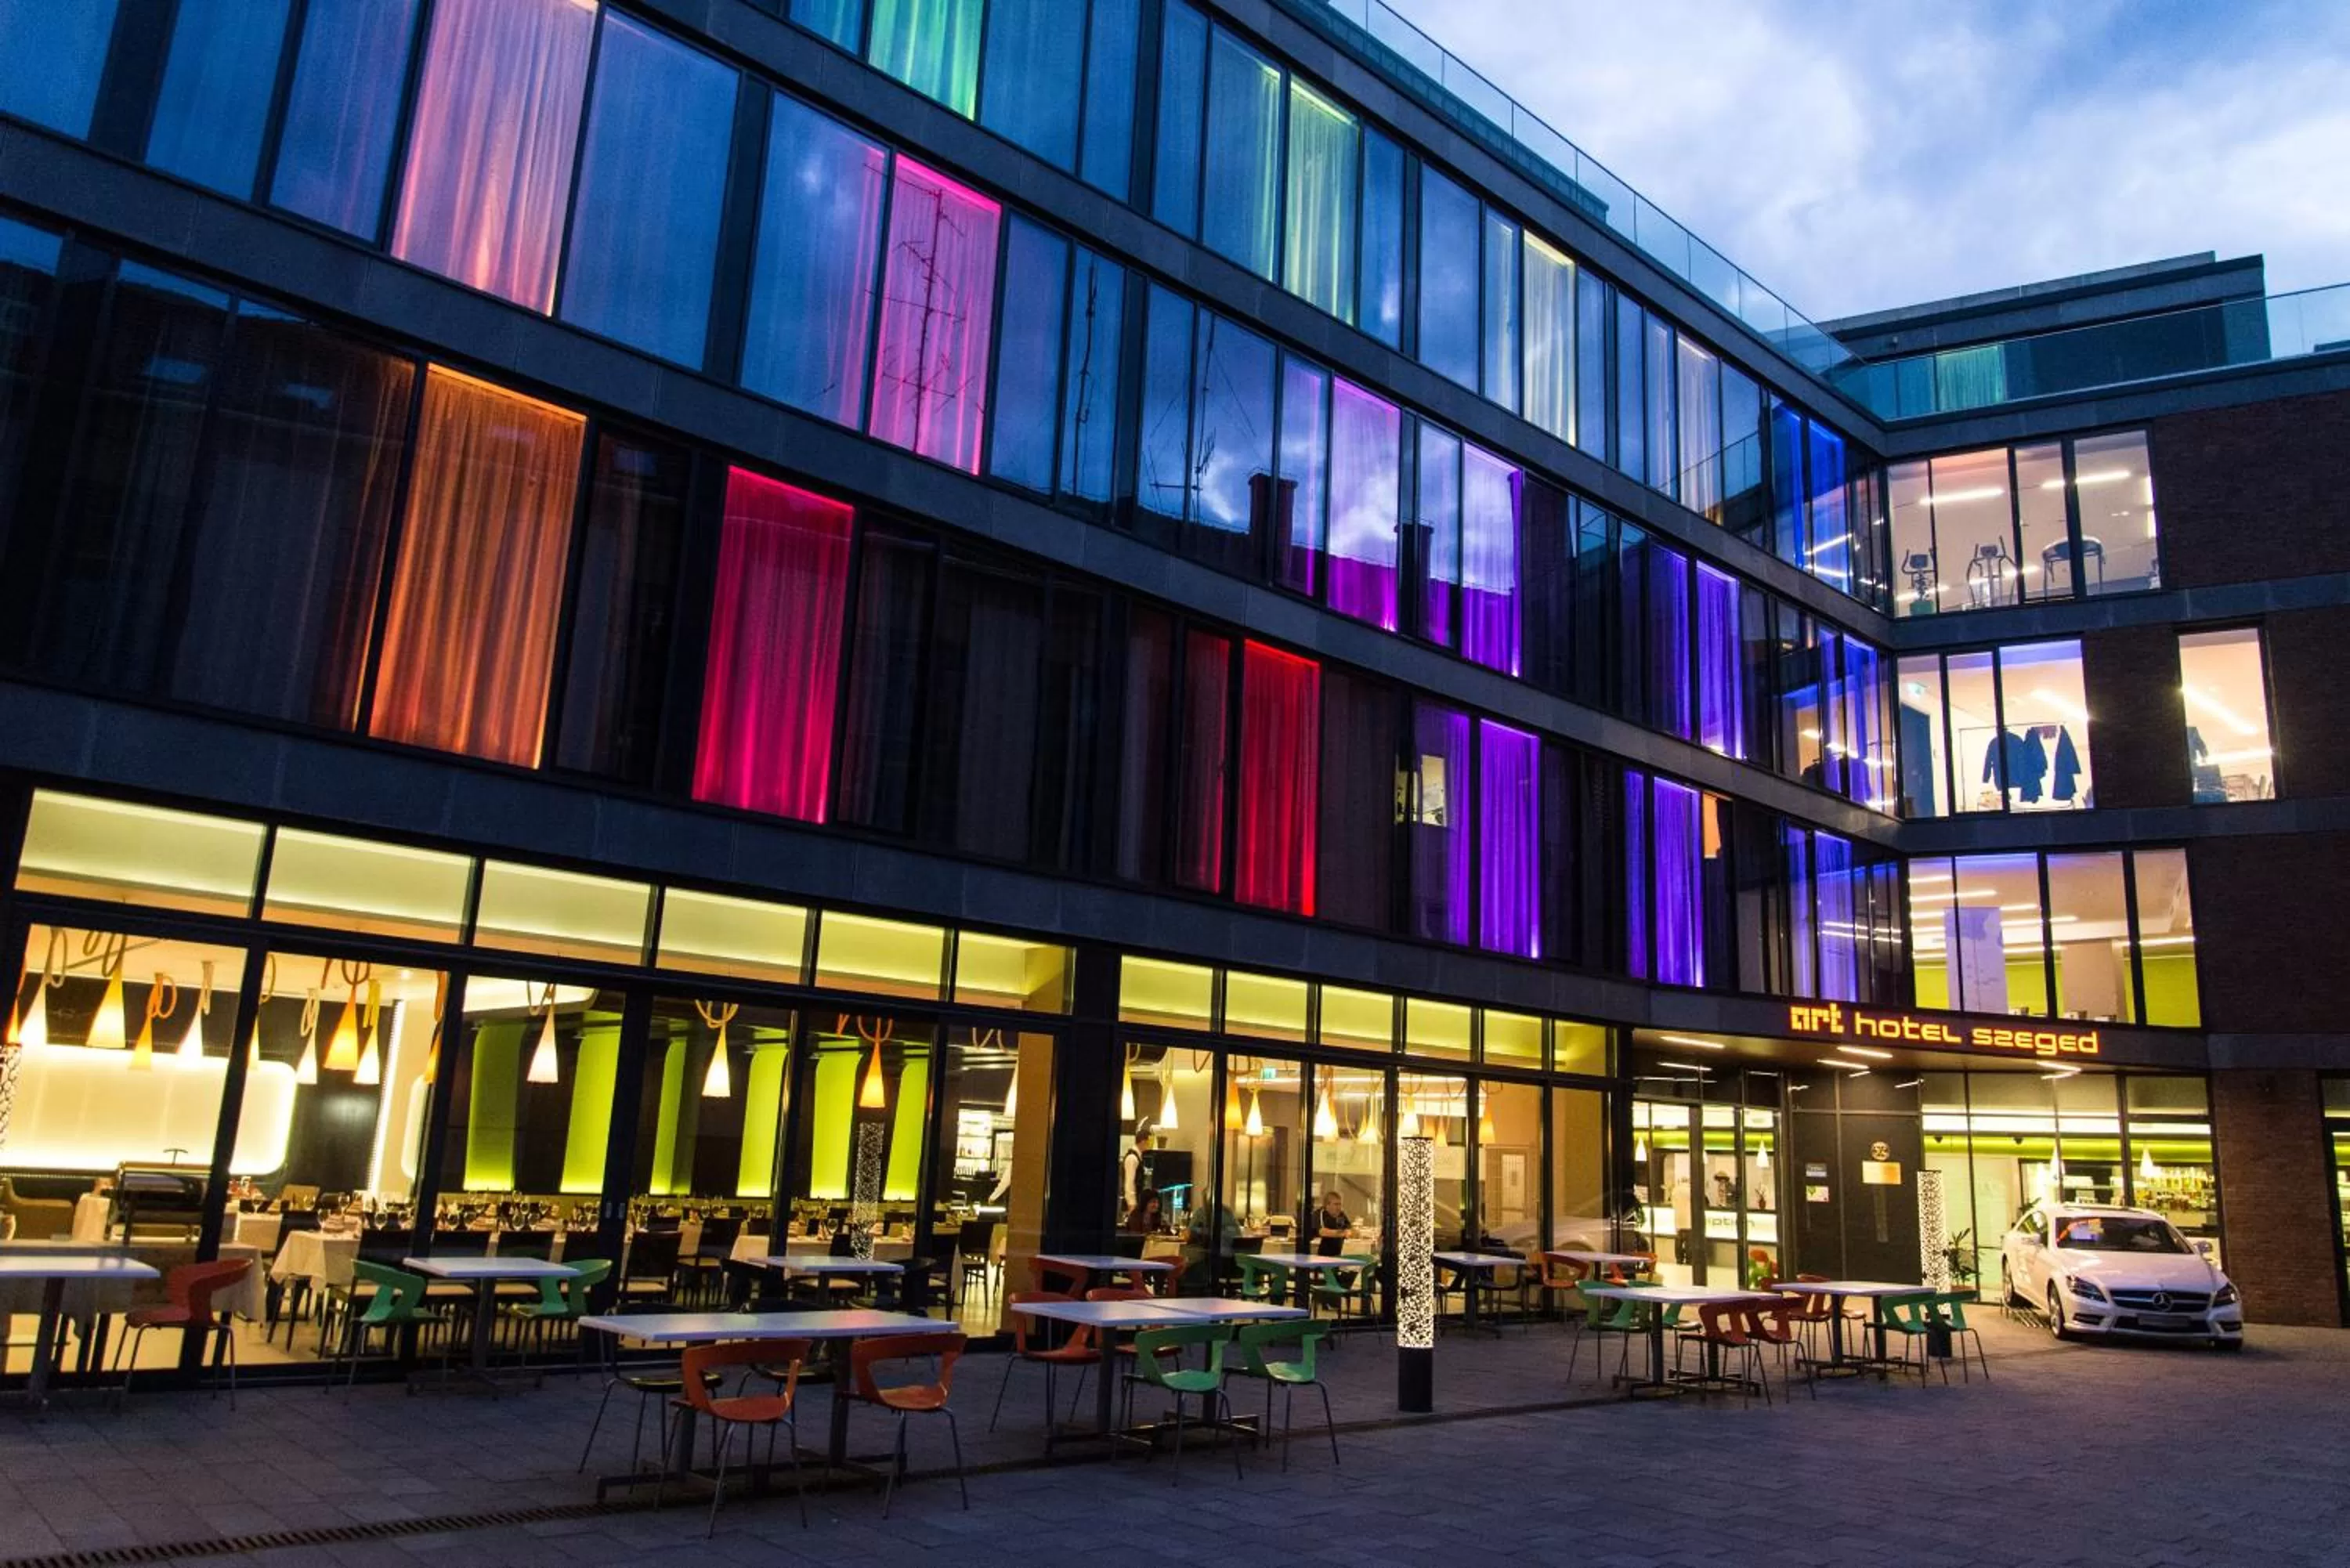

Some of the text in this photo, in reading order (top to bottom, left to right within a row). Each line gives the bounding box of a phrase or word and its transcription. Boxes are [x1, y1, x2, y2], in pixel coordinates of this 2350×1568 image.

[1791, 1003, 2099, 1056] art hotel szeged
